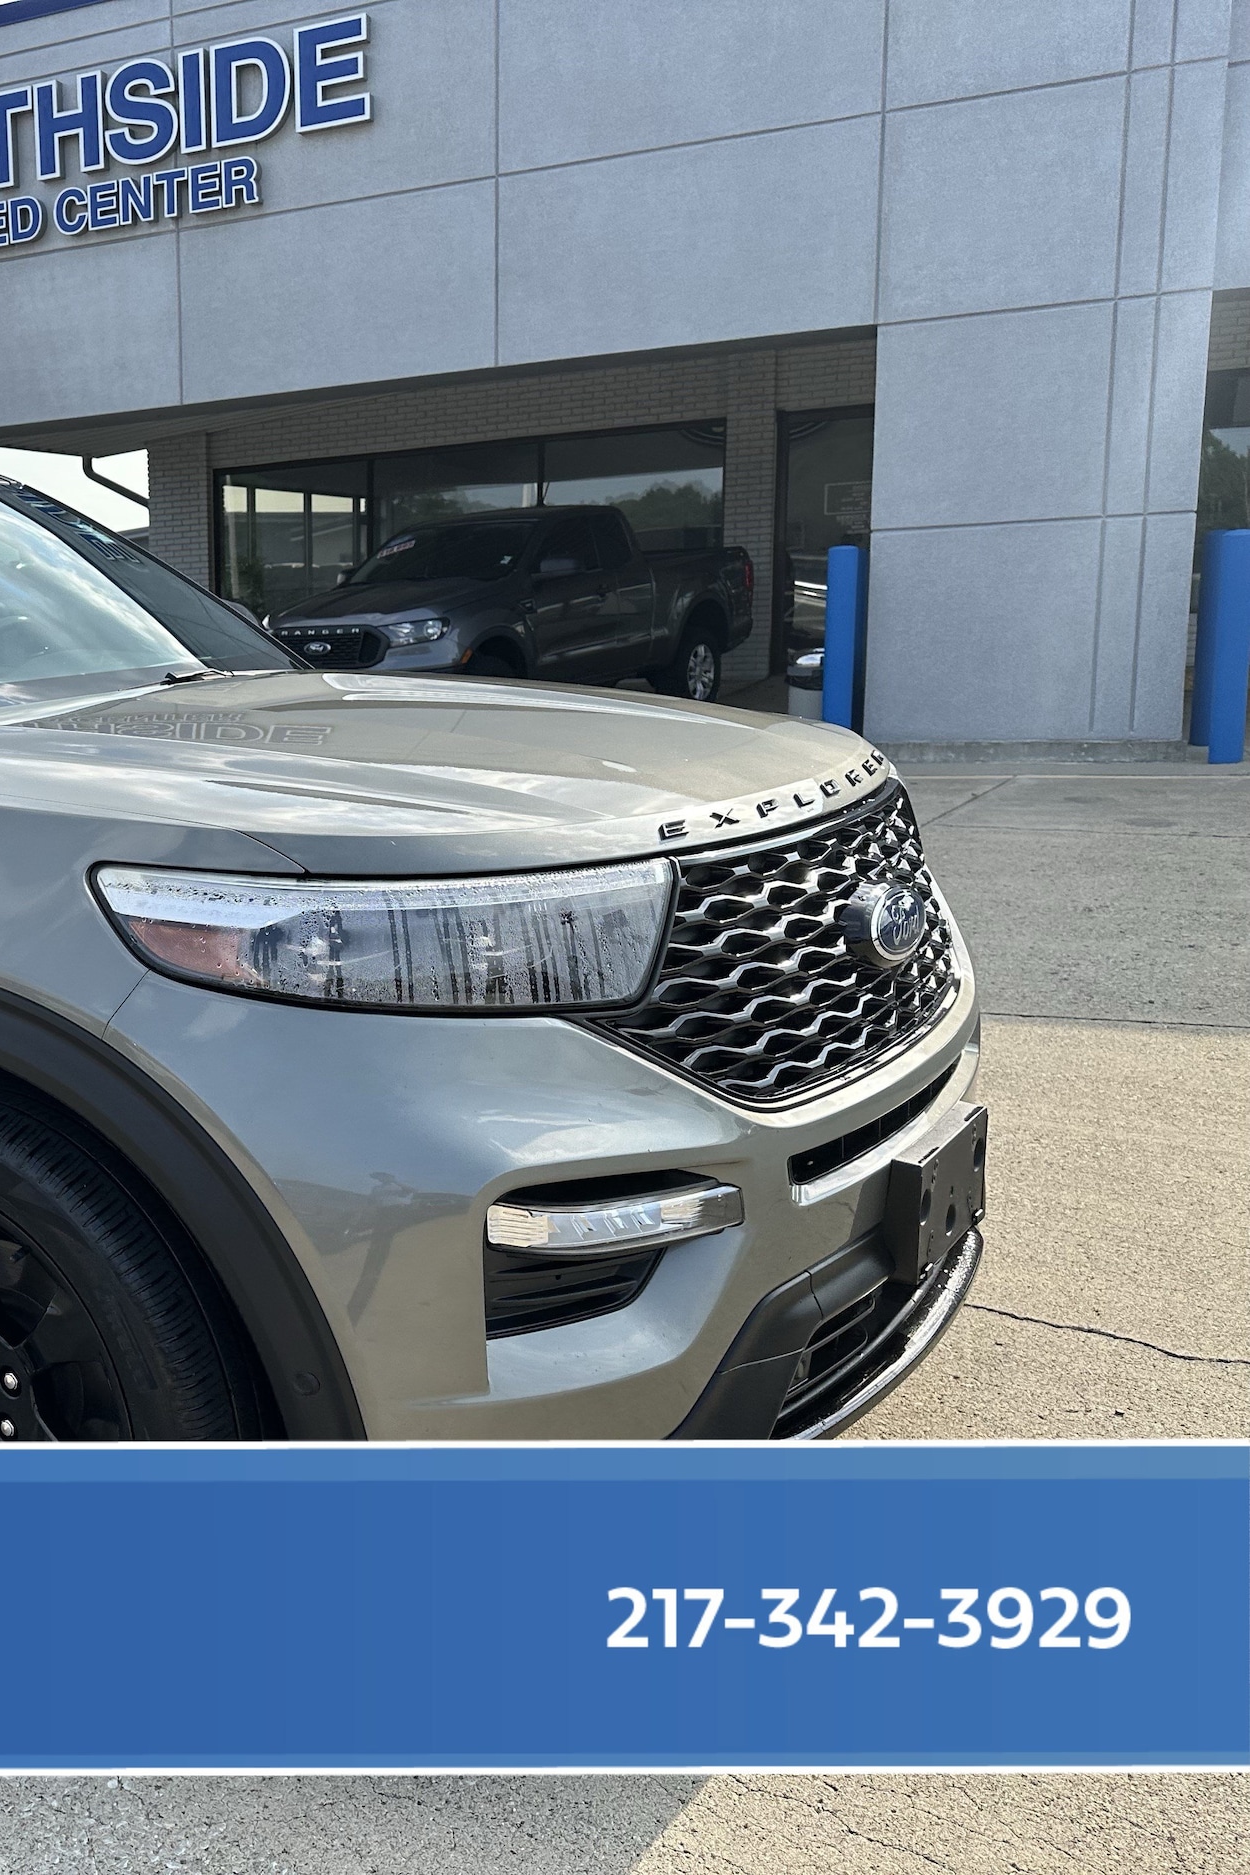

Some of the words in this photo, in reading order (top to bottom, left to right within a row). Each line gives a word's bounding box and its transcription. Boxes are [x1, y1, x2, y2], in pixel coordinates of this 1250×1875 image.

[53, 156, 259, 236] CENTER
[281, 627, 361, 636] RANGER
[658, 750, 885, 840] EXPLORER
